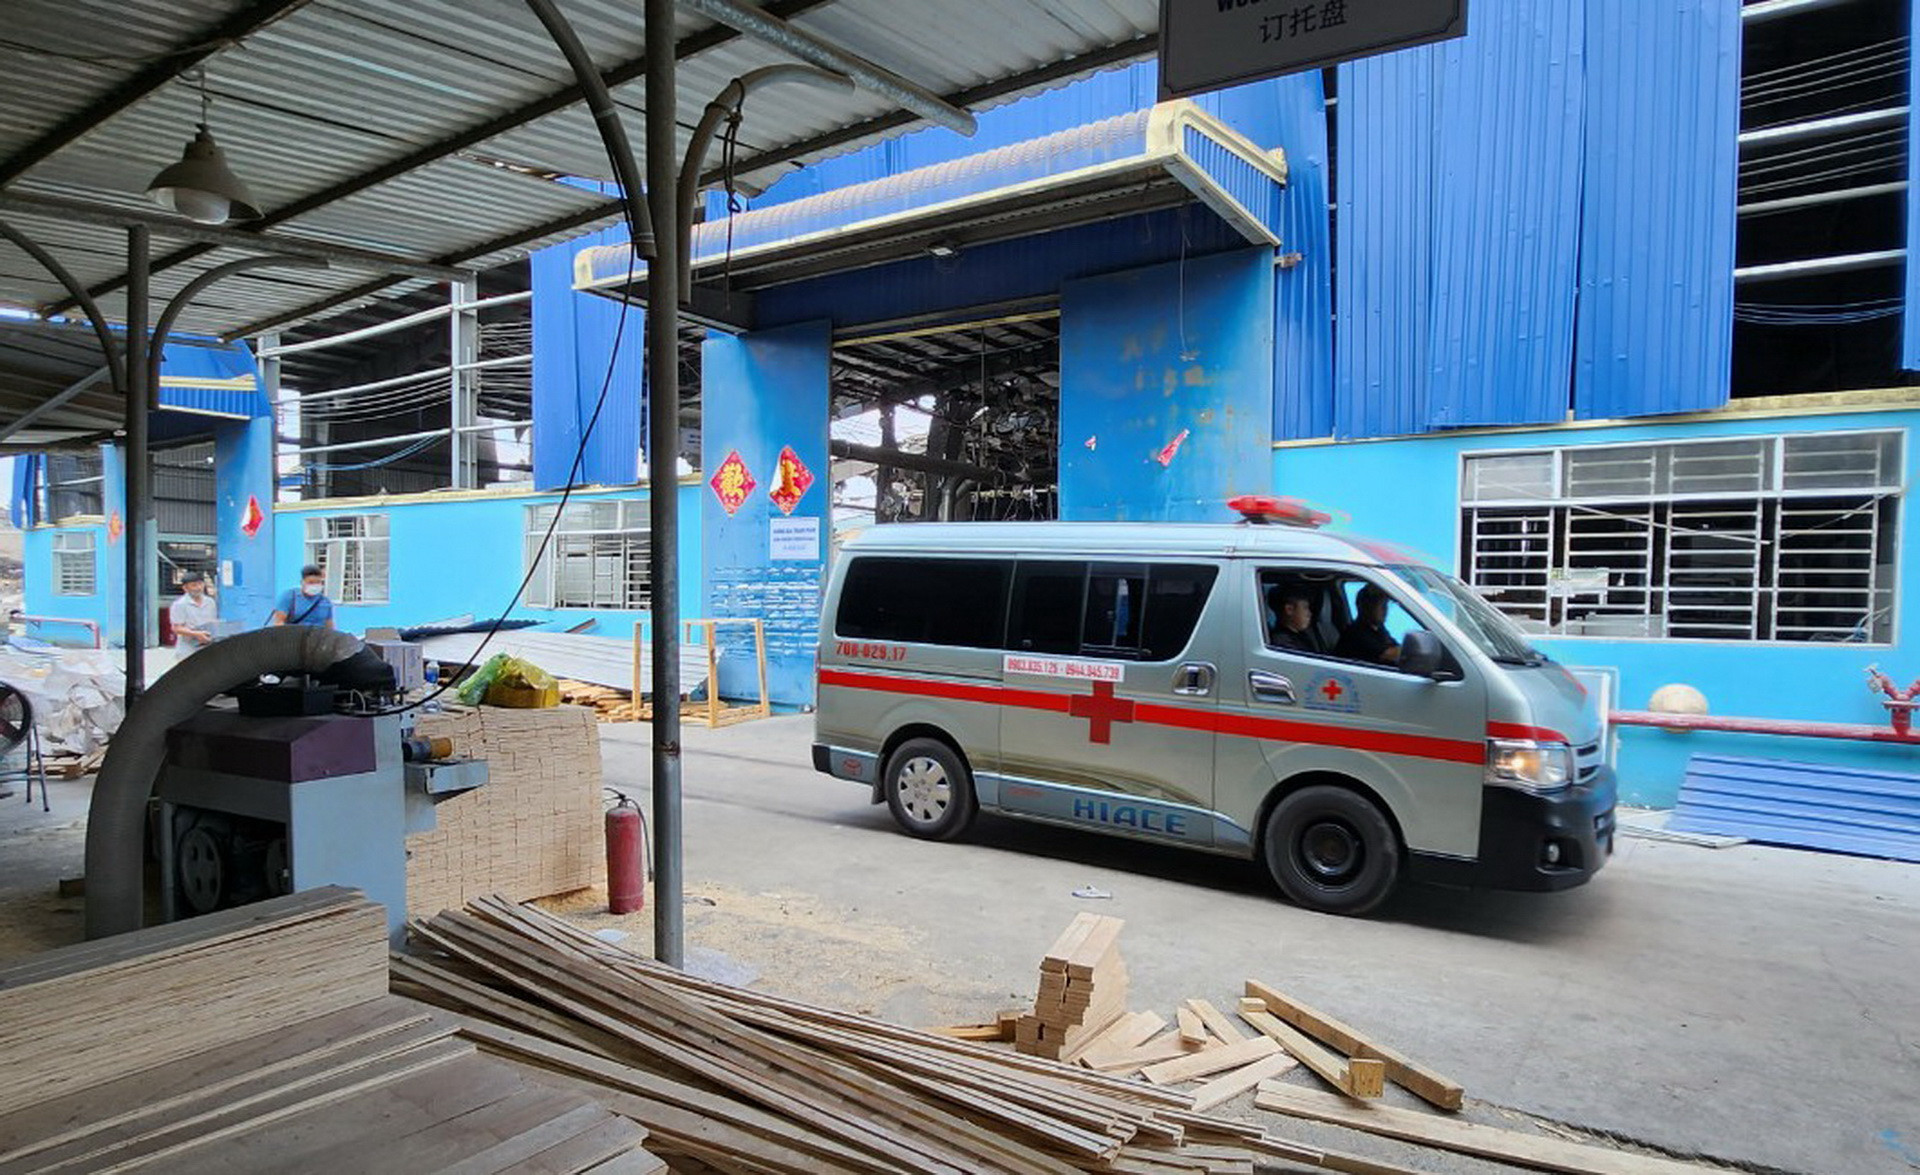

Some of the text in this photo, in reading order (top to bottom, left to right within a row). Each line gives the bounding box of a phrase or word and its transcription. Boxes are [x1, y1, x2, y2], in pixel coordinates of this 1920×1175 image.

[1258, 0, 1347, 43] 订托盘
[1073, 797, 1187, 836] HIACE
